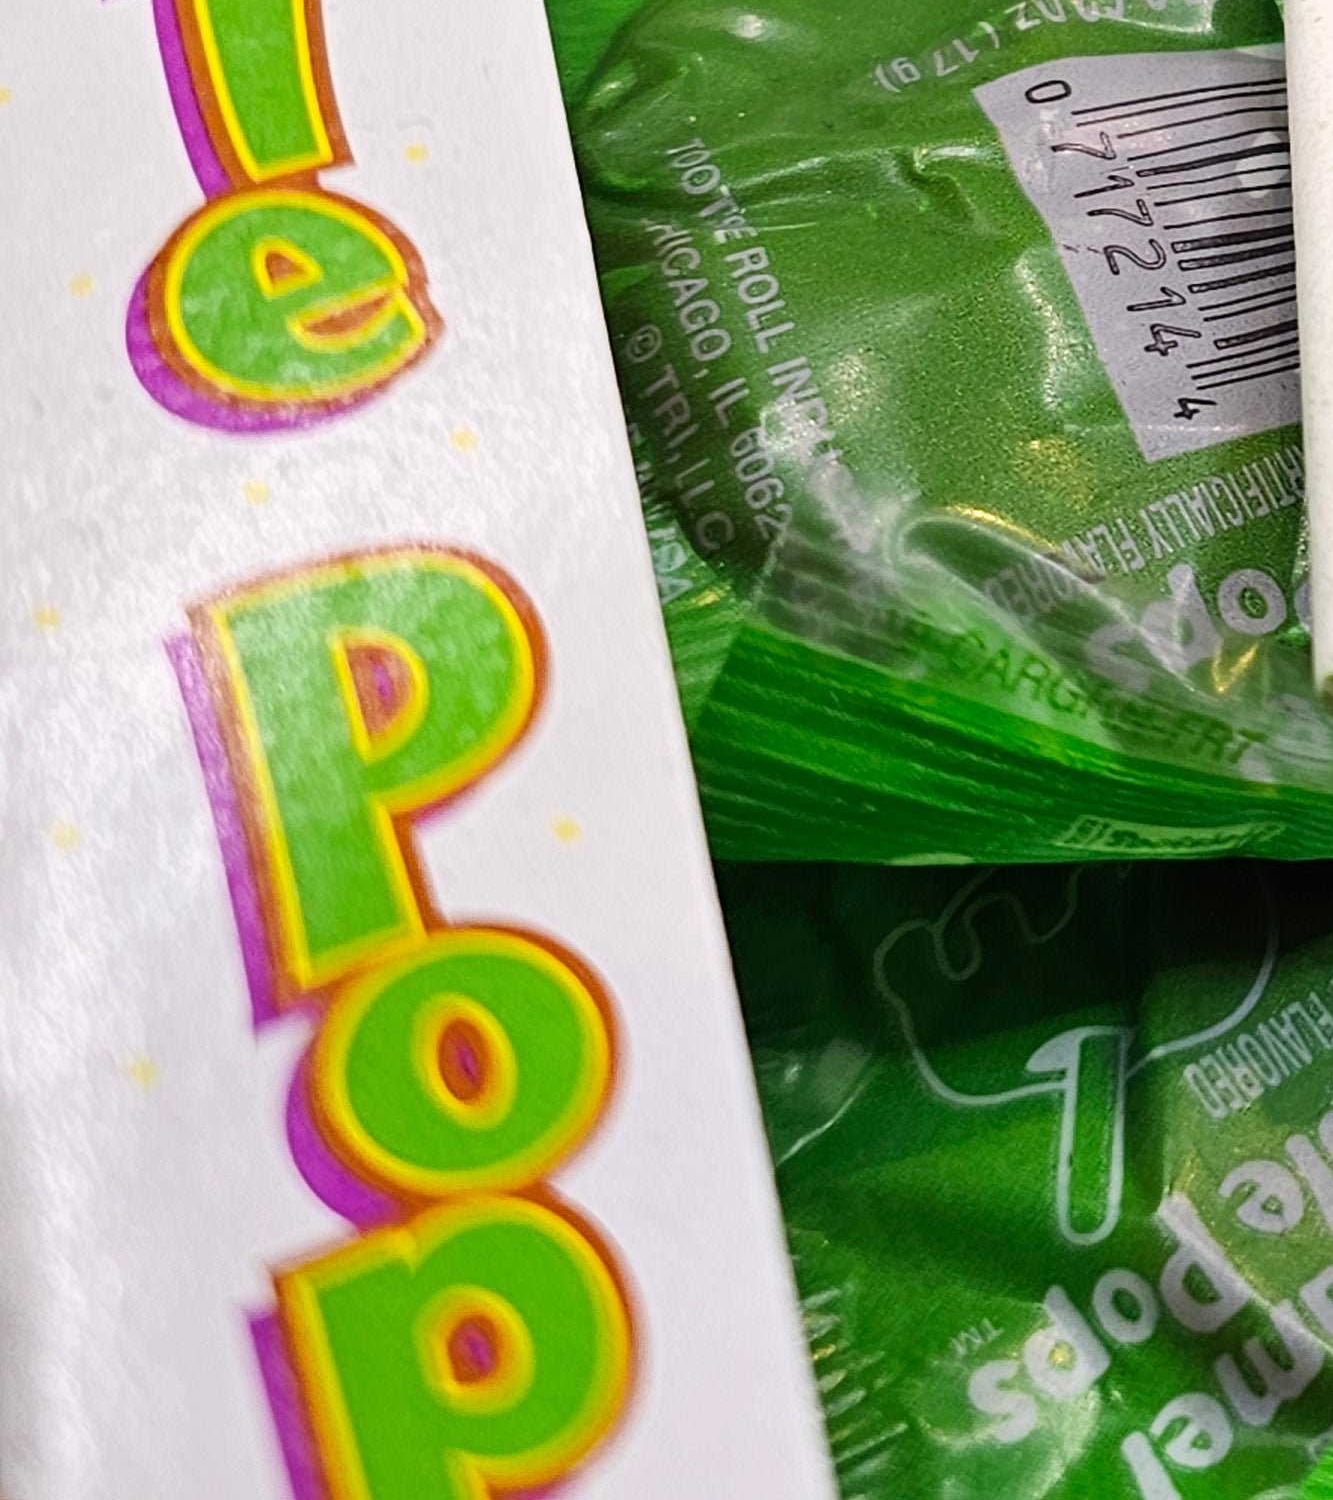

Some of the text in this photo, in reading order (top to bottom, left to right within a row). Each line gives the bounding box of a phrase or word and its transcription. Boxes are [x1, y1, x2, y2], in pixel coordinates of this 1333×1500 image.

[1024, 79, 1074, 104] 0
[726, 245, 796, 354] ROLL
[710, 376, 752, 430] IL
[1173, 393, 1220, 426] 4
[643, 364, 702, 462] TRI,
[677, 457, 738, 552] LLC
[967, 1191, 1254, 1444] Pops
